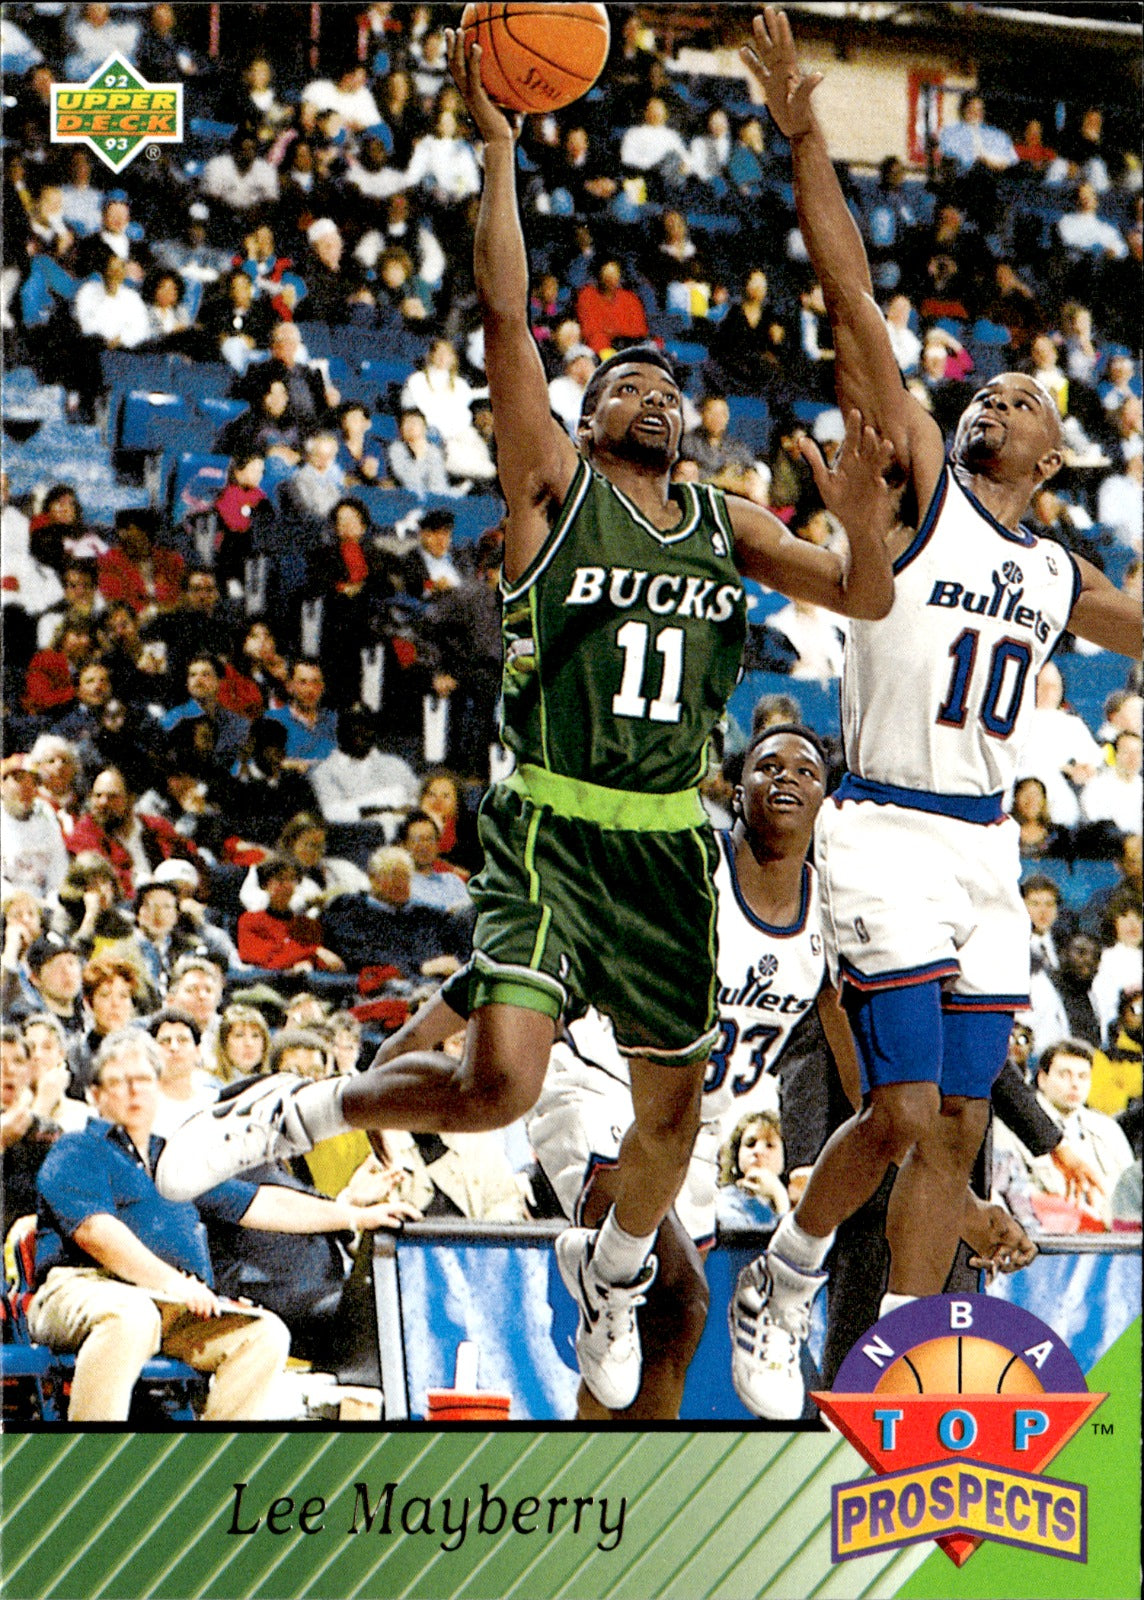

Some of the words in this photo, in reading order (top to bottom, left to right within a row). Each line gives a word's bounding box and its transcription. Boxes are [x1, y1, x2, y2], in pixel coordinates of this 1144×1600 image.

[563, 566, 743, 622] BUCKS
[926, 569, 1051, 645] Bullets
[612, 620, 685, 723] 11
[935, 626, 1033, 741] 10
[718, 965, 814, 1014] ullets
[702, 1017, 784, 1098] 33
